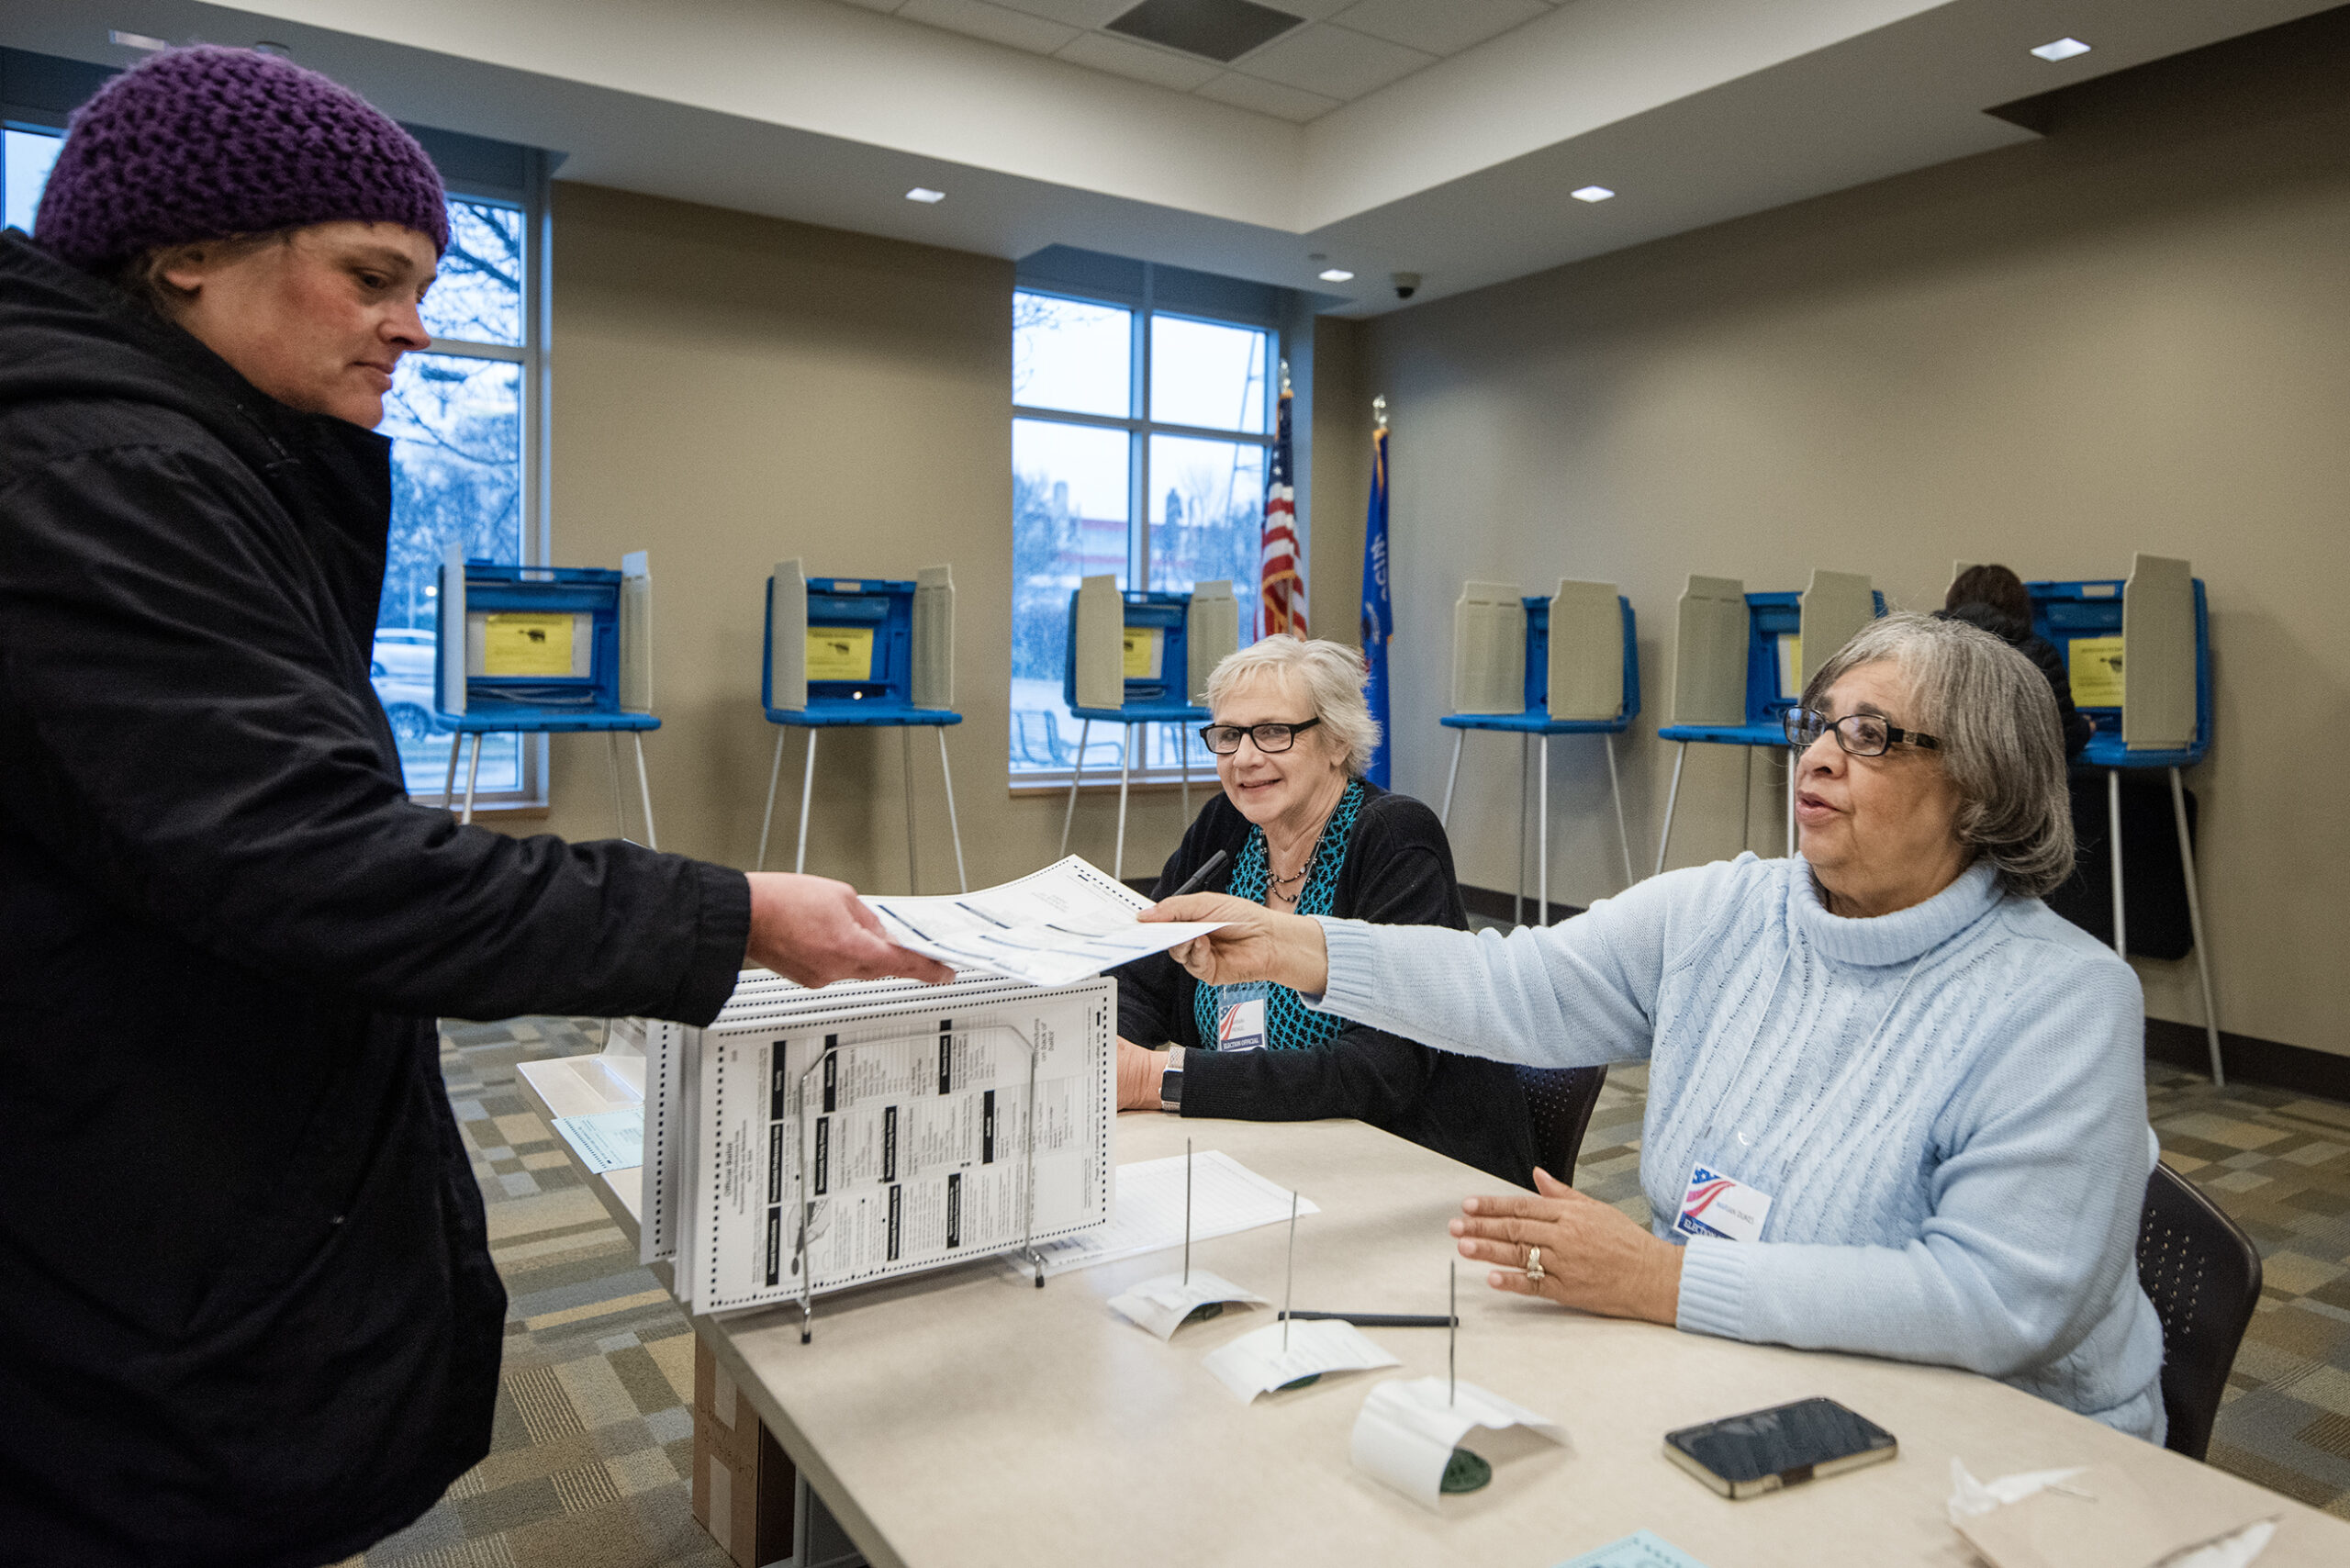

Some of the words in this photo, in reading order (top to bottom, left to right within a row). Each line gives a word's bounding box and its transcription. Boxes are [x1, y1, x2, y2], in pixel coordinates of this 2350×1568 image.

[1224, 1040, 1241, 1049] ELECTION
[1241, 1037, 1259, 1047] OFFICIAL
[724, 1141, 733, 1166] Ballot
[723, 1167, 732, 1197] Official
